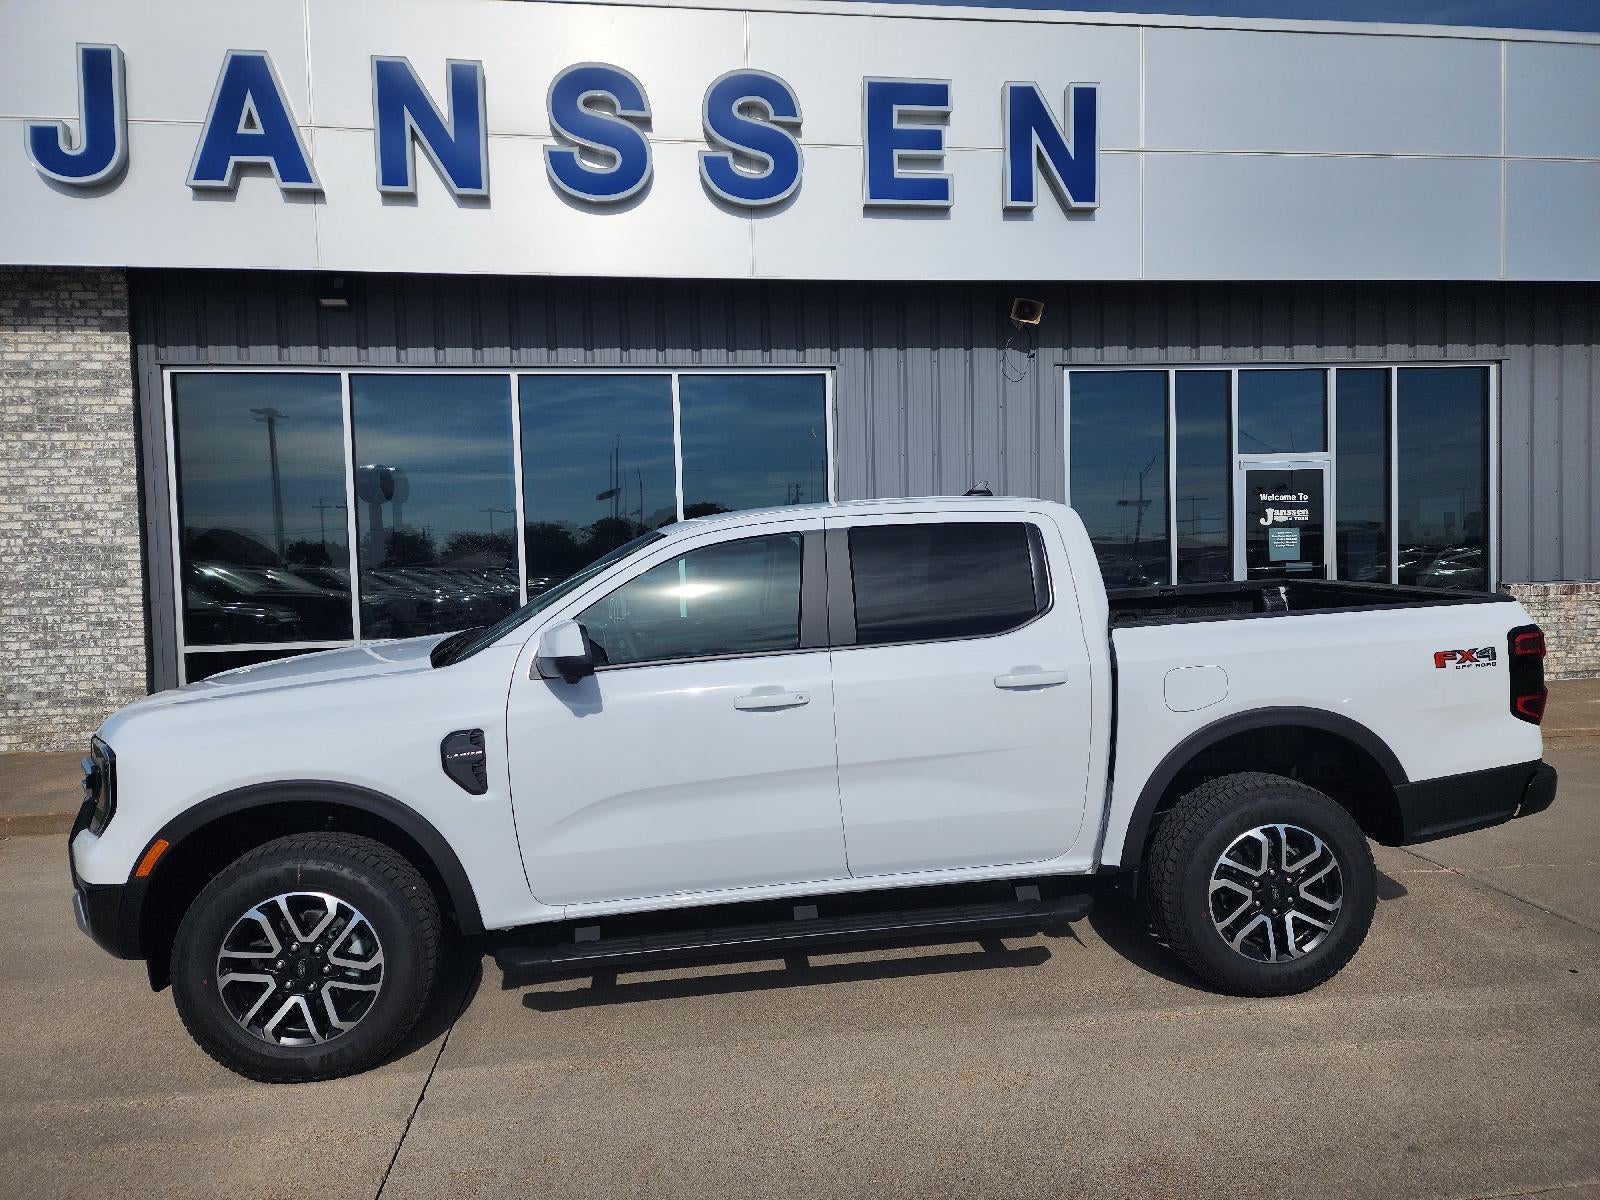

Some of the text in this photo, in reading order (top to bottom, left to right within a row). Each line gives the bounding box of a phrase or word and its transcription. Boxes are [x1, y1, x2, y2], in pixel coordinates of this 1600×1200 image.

[23, 42, 1100, 211] JANSSEN
[1298, 492, 1308, 500] To
[1260, 508, 1309, 525] Janssen
[1434, 647, 1497, 668] FX4
